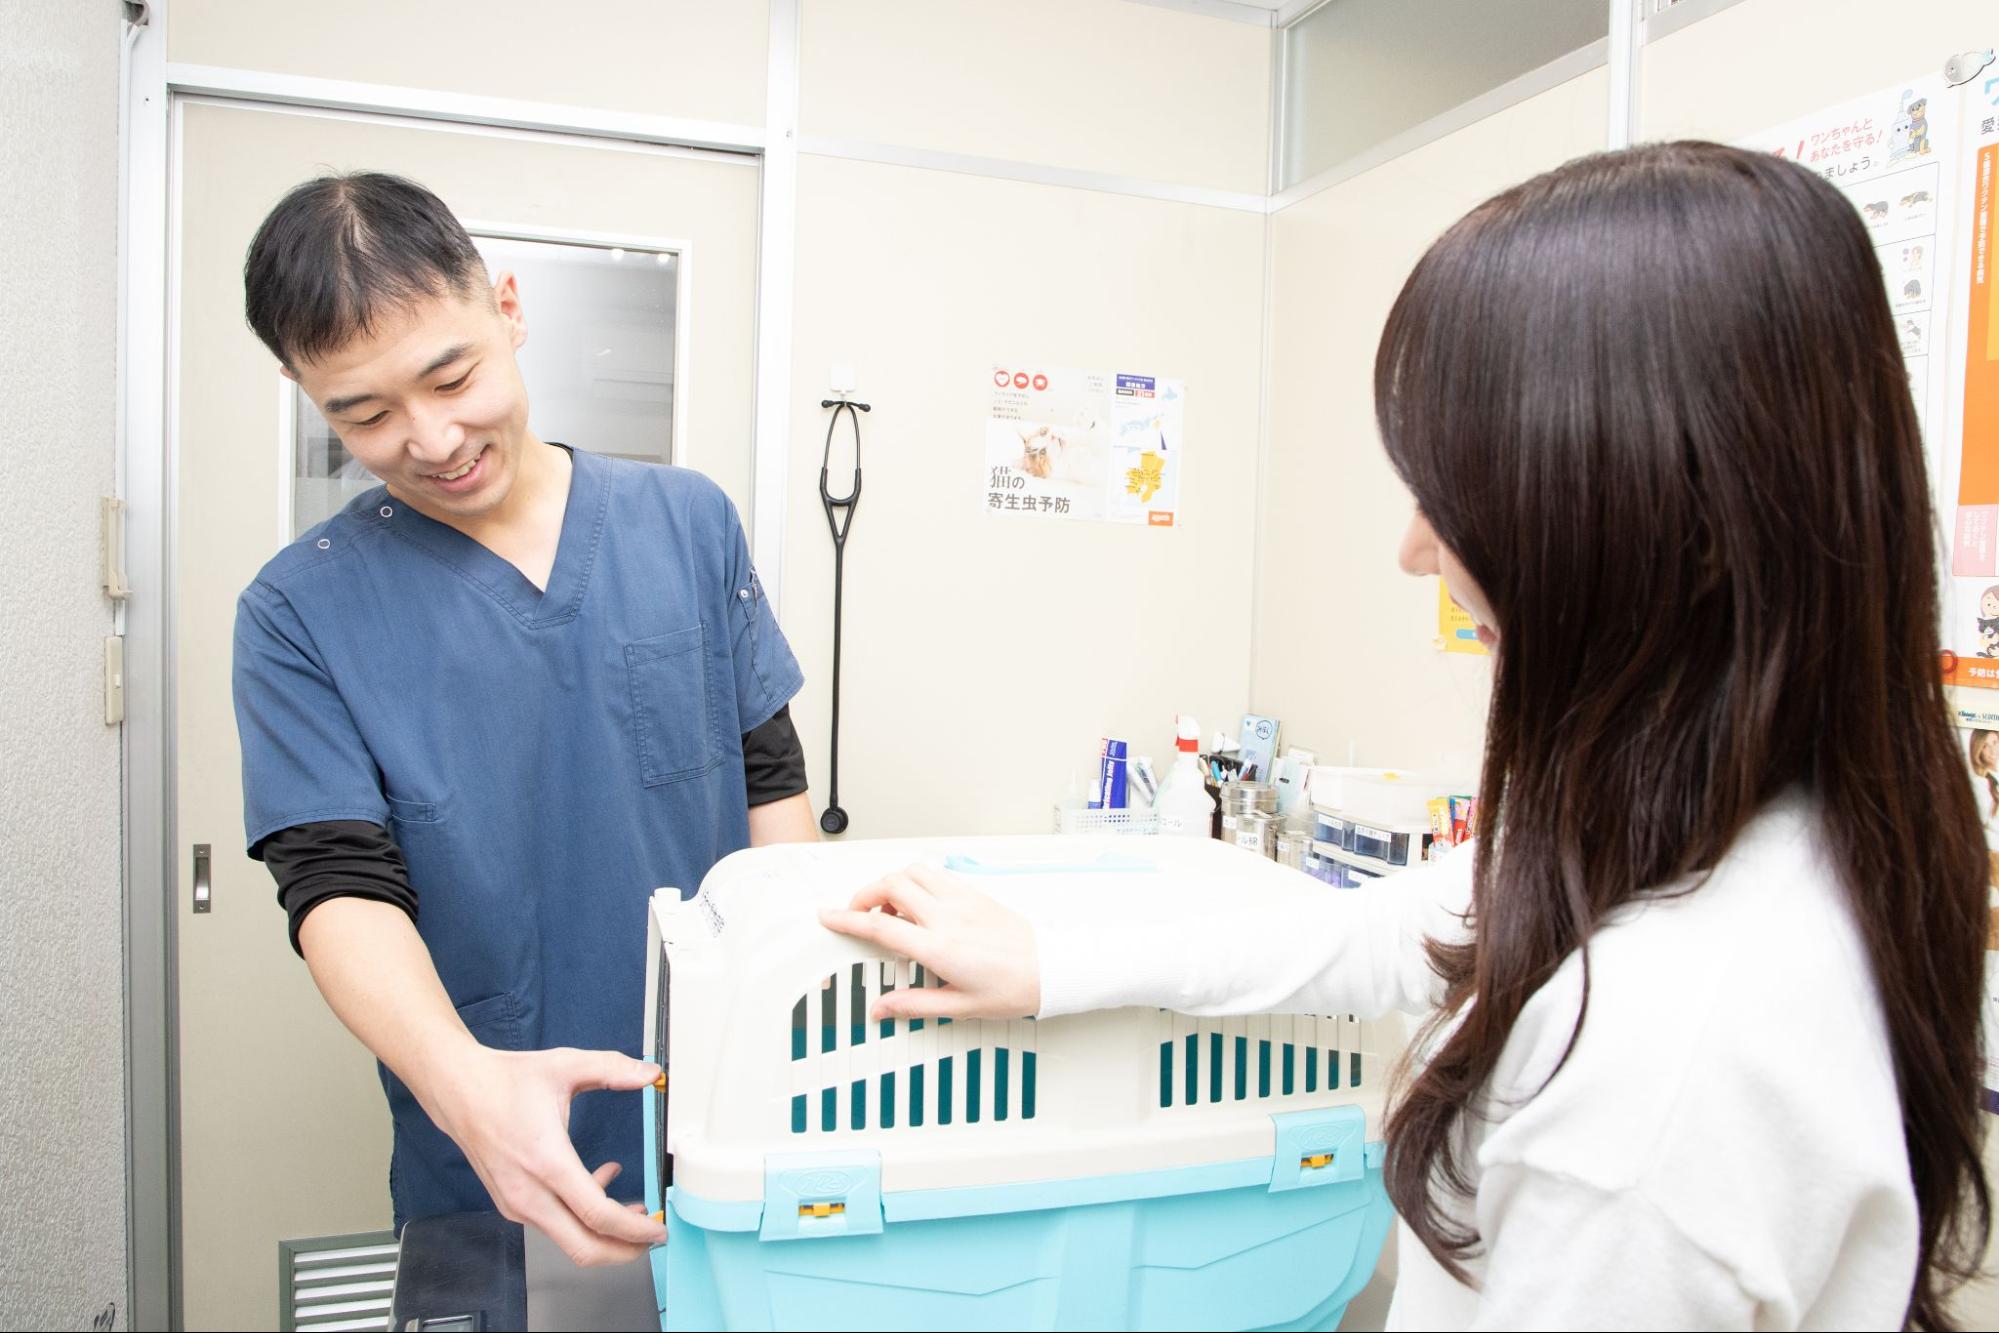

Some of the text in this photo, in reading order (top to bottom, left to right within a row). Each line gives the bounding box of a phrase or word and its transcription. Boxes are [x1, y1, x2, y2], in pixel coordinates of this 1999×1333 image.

[1810, 118, 1873, 145] ワンちゃんと
[1809, 131, 1883, 162] あなたを守る!
[991, 466, 1025, 490] 猫の
[988, 493, 1070, 514] 寄生虫予防
